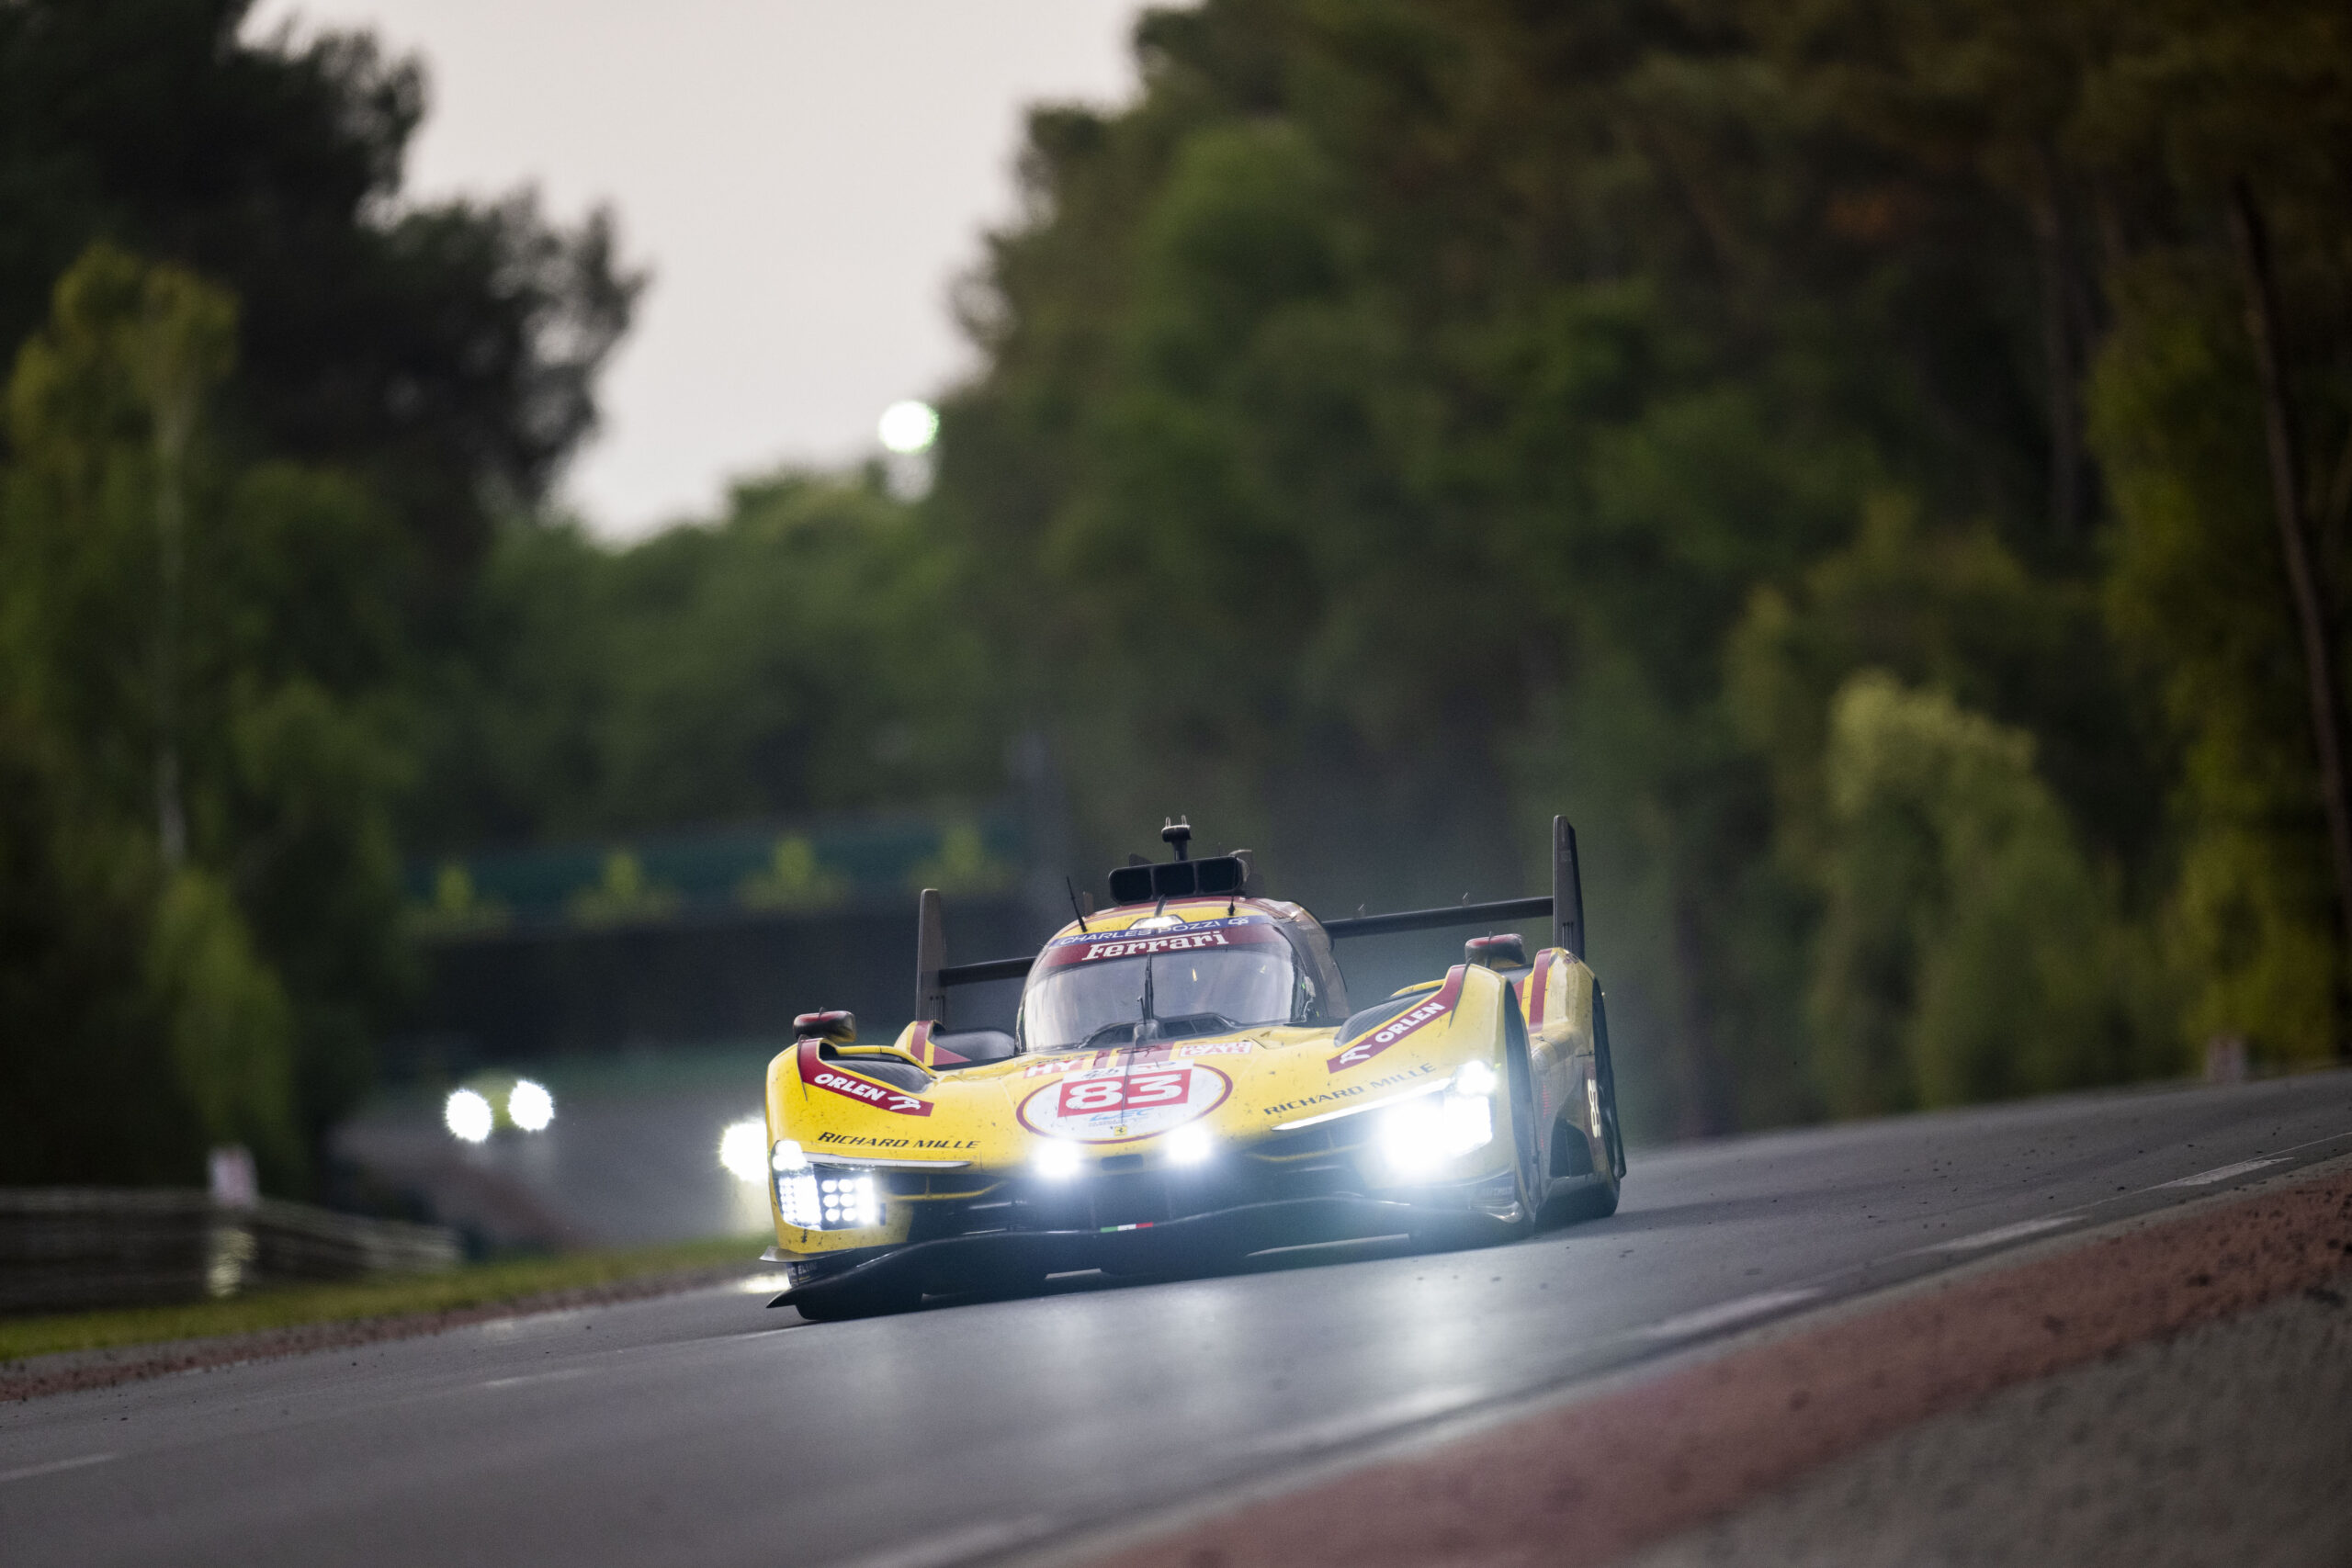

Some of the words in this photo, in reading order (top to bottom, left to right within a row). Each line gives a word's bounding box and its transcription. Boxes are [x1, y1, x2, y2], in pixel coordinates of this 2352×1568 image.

[1060, 928, 1151, 946] CHARLES
[1081, 931, 1229, 961] Ferrari
[1374, 1002, 1446, 1043] ORLEN
[1026, 1059, 1080, 1077] HY
[814, 1073, 887, 1101] ORLEN
[1066, 1073, 1182, 1109] 83
[1263, 1086, 1365, 1115] RICHARD
[1370, 1063, 1437, 1089] MILLE
[818, 1132, 909, 1148] RICHARD
[912, 1140, 981, 1149] MILLE
